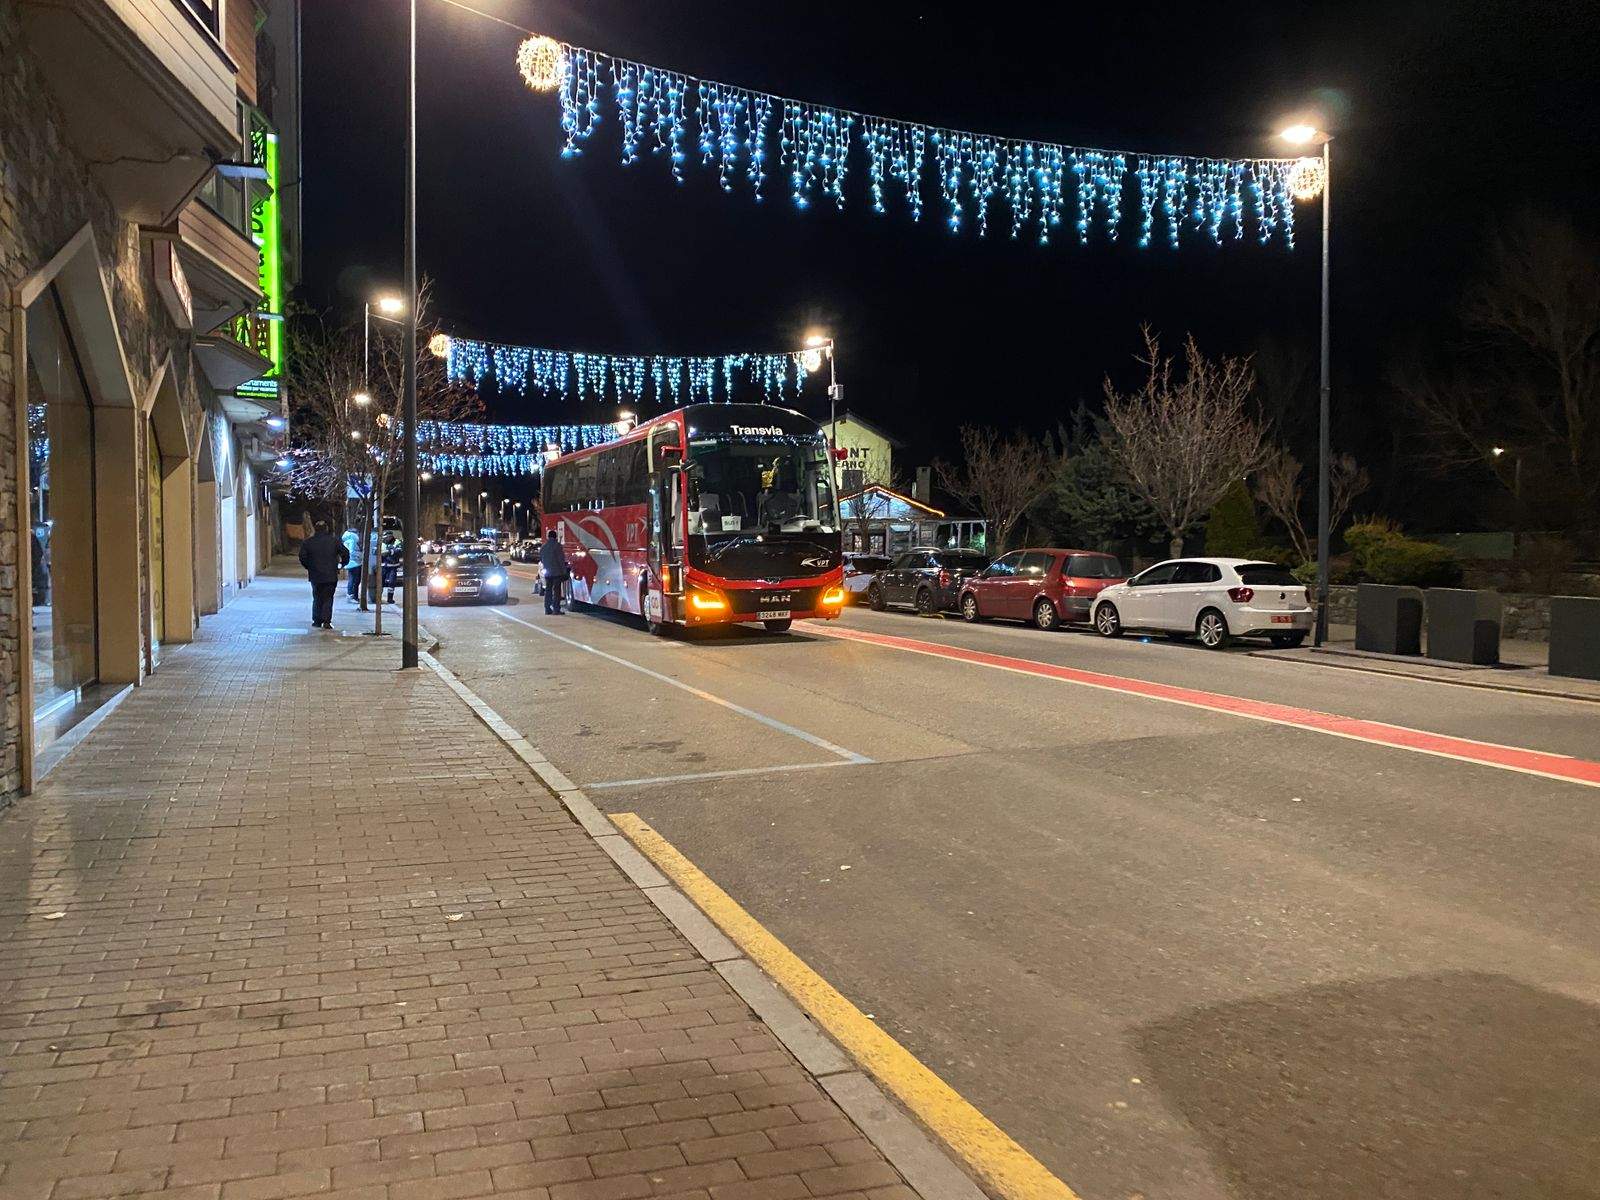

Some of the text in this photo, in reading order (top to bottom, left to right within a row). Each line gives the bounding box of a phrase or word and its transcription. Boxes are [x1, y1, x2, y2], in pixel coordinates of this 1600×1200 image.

[730, 425, 783, 436] Transvia
[850, 447, 870, 459] NT
[760, 595, 791, 603] MAN
